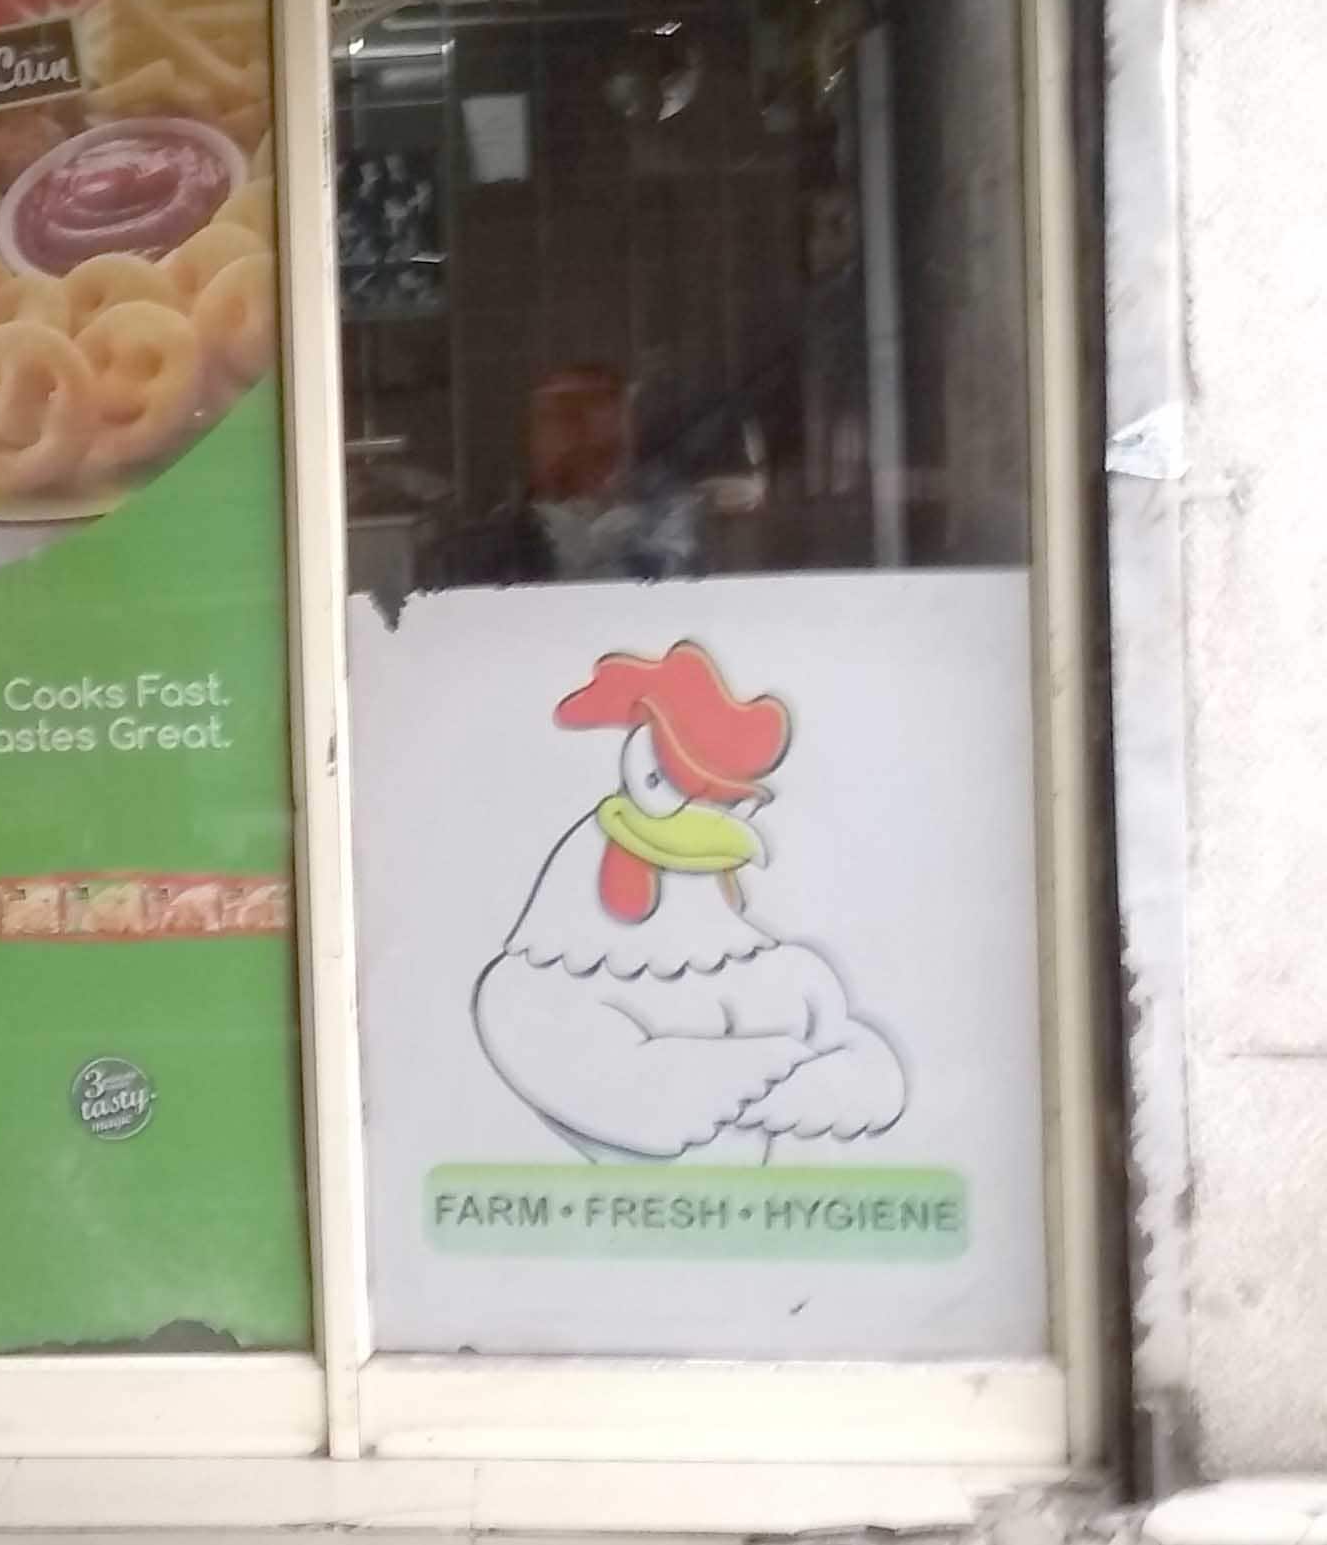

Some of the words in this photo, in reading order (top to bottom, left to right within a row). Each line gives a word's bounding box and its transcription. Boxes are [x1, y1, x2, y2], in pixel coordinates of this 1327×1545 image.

[3, 675, 127, 712] Cooks
[136, 672, 233, 709] Fast.
[107, 715, 233, 752] Great.
[84, 1069, 104, 1098] 3
[433, 1192, 550, 1229] FARM
[584, 1192, 729, 1230] FRESH
[762, 1196, 962, 1233] HYGIENE
